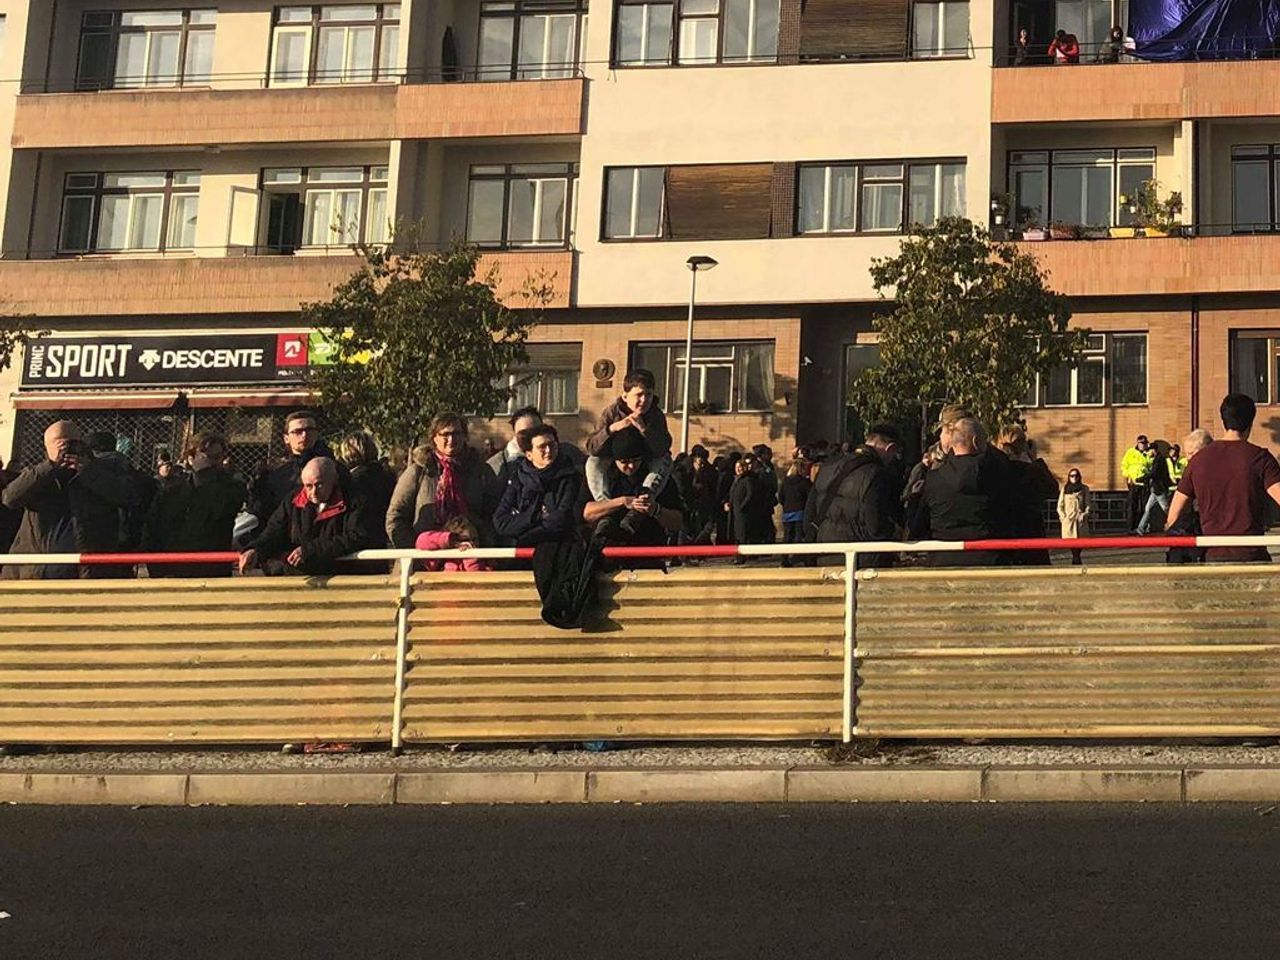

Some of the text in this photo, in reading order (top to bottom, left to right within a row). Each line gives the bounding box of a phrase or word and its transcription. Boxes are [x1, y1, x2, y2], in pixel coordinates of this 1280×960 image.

[28, 345, 45, 378] PRINC
[45, 344, 133, 378] SPORT
[162, 348, 264, 369] DESCENTE
